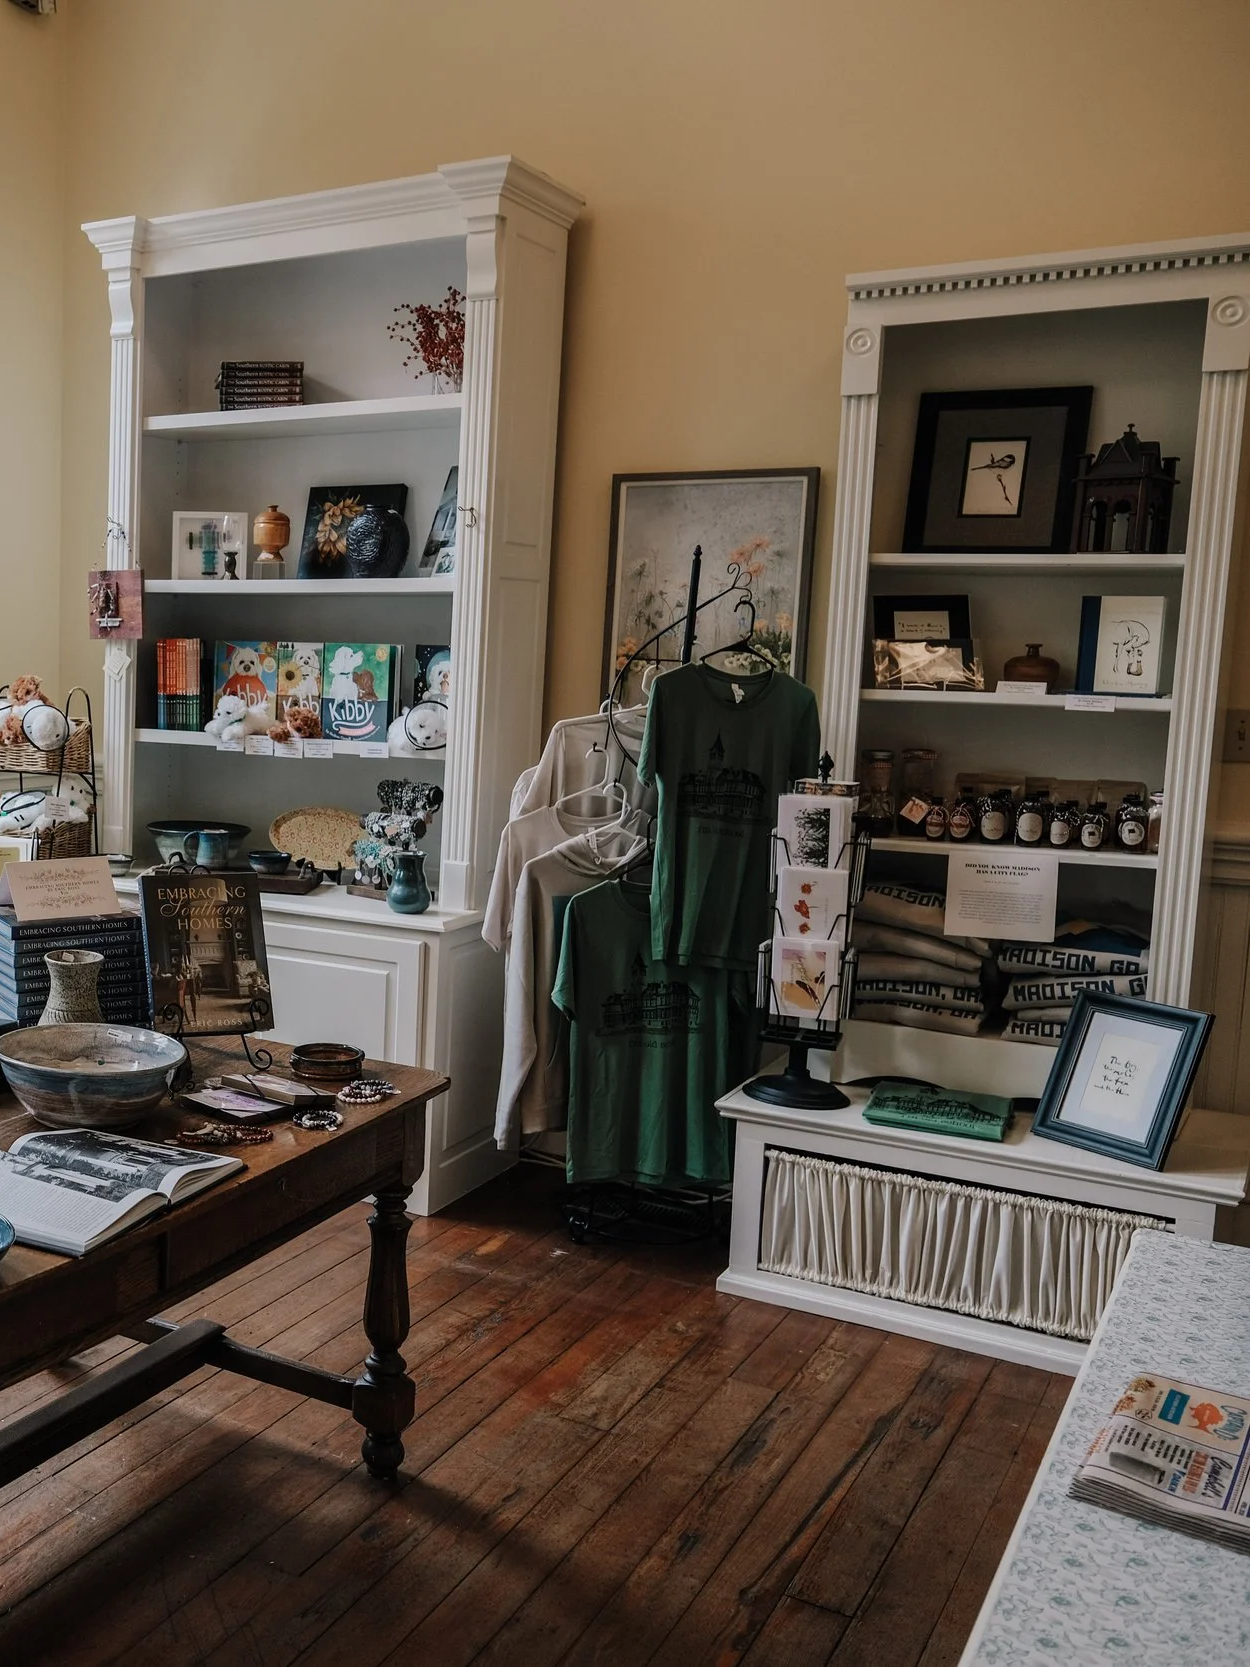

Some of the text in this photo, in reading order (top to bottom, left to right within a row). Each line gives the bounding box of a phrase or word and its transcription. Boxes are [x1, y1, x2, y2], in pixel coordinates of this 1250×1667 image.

[329, 696, 375, 726] Kibby
[158, 886, 246, 900] EMBRACING
[160, 897, 246, 917] Southern
[19, 921, 128, 936] EMBRACING SOUTHERN HOMES
[178, 917, 233, 930] HOMES
[23, 940, 66, 950] EMBRACING
[65, 937, 104, 946] SOUTHERN
[191, 1018, 243, 1027] ERIC ROSS
